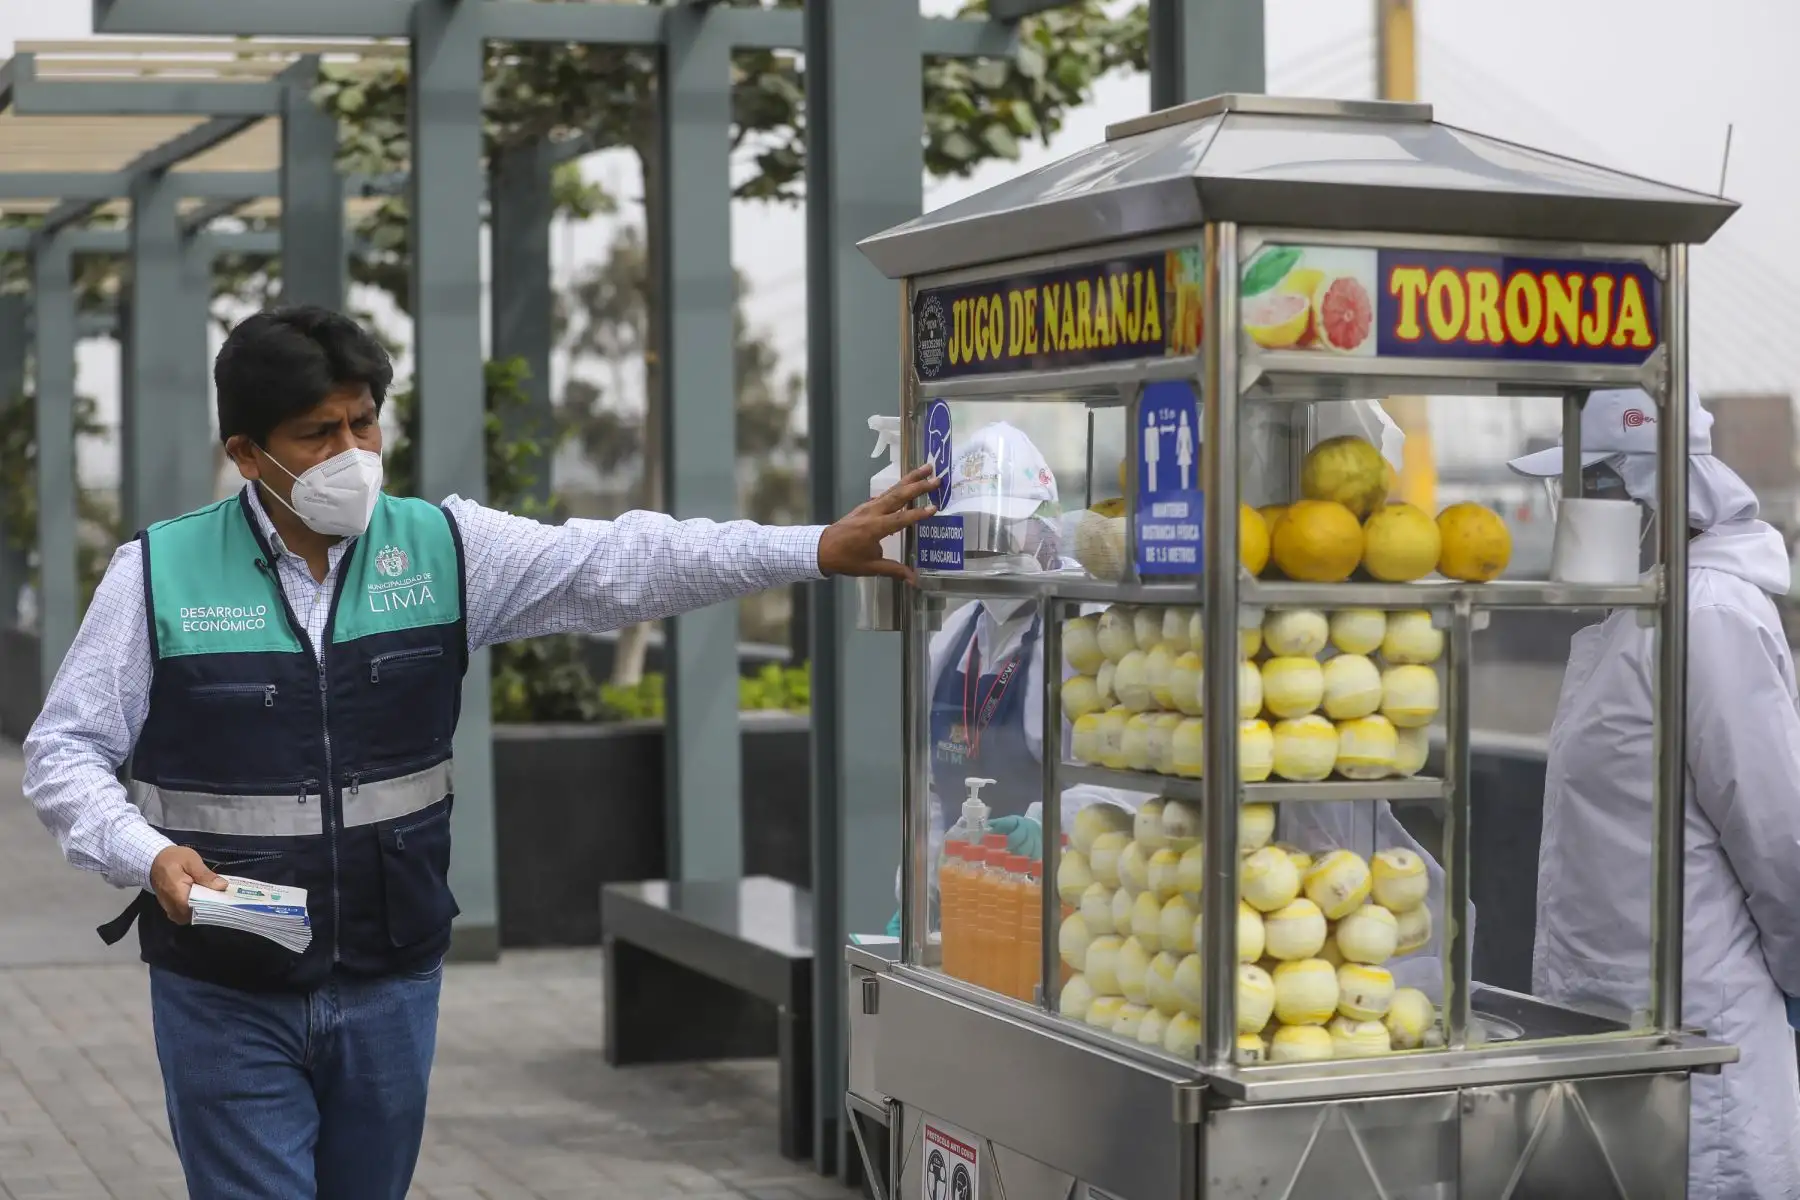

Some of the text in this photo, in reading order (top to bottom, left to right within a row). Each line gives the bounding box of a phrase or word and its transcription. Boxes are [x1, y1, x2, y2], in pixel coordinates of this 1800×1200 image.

[1390, 266, 1653, 347] TORONJA
[948, 268, 1162, 365] JUGO DE NARANJA
[919, 525, 963, 540] USO OBLIGATORIO
[920, 549, 961, 564] DE MASCARILLA
[367, 572, 432, 590] MUNICIPALIDAD DE
[369, 585, 435, 612] LIMA
[180, 605, 266, 618] DESARROLLO
[182, 618, 265, 632] ECONÓMICO
